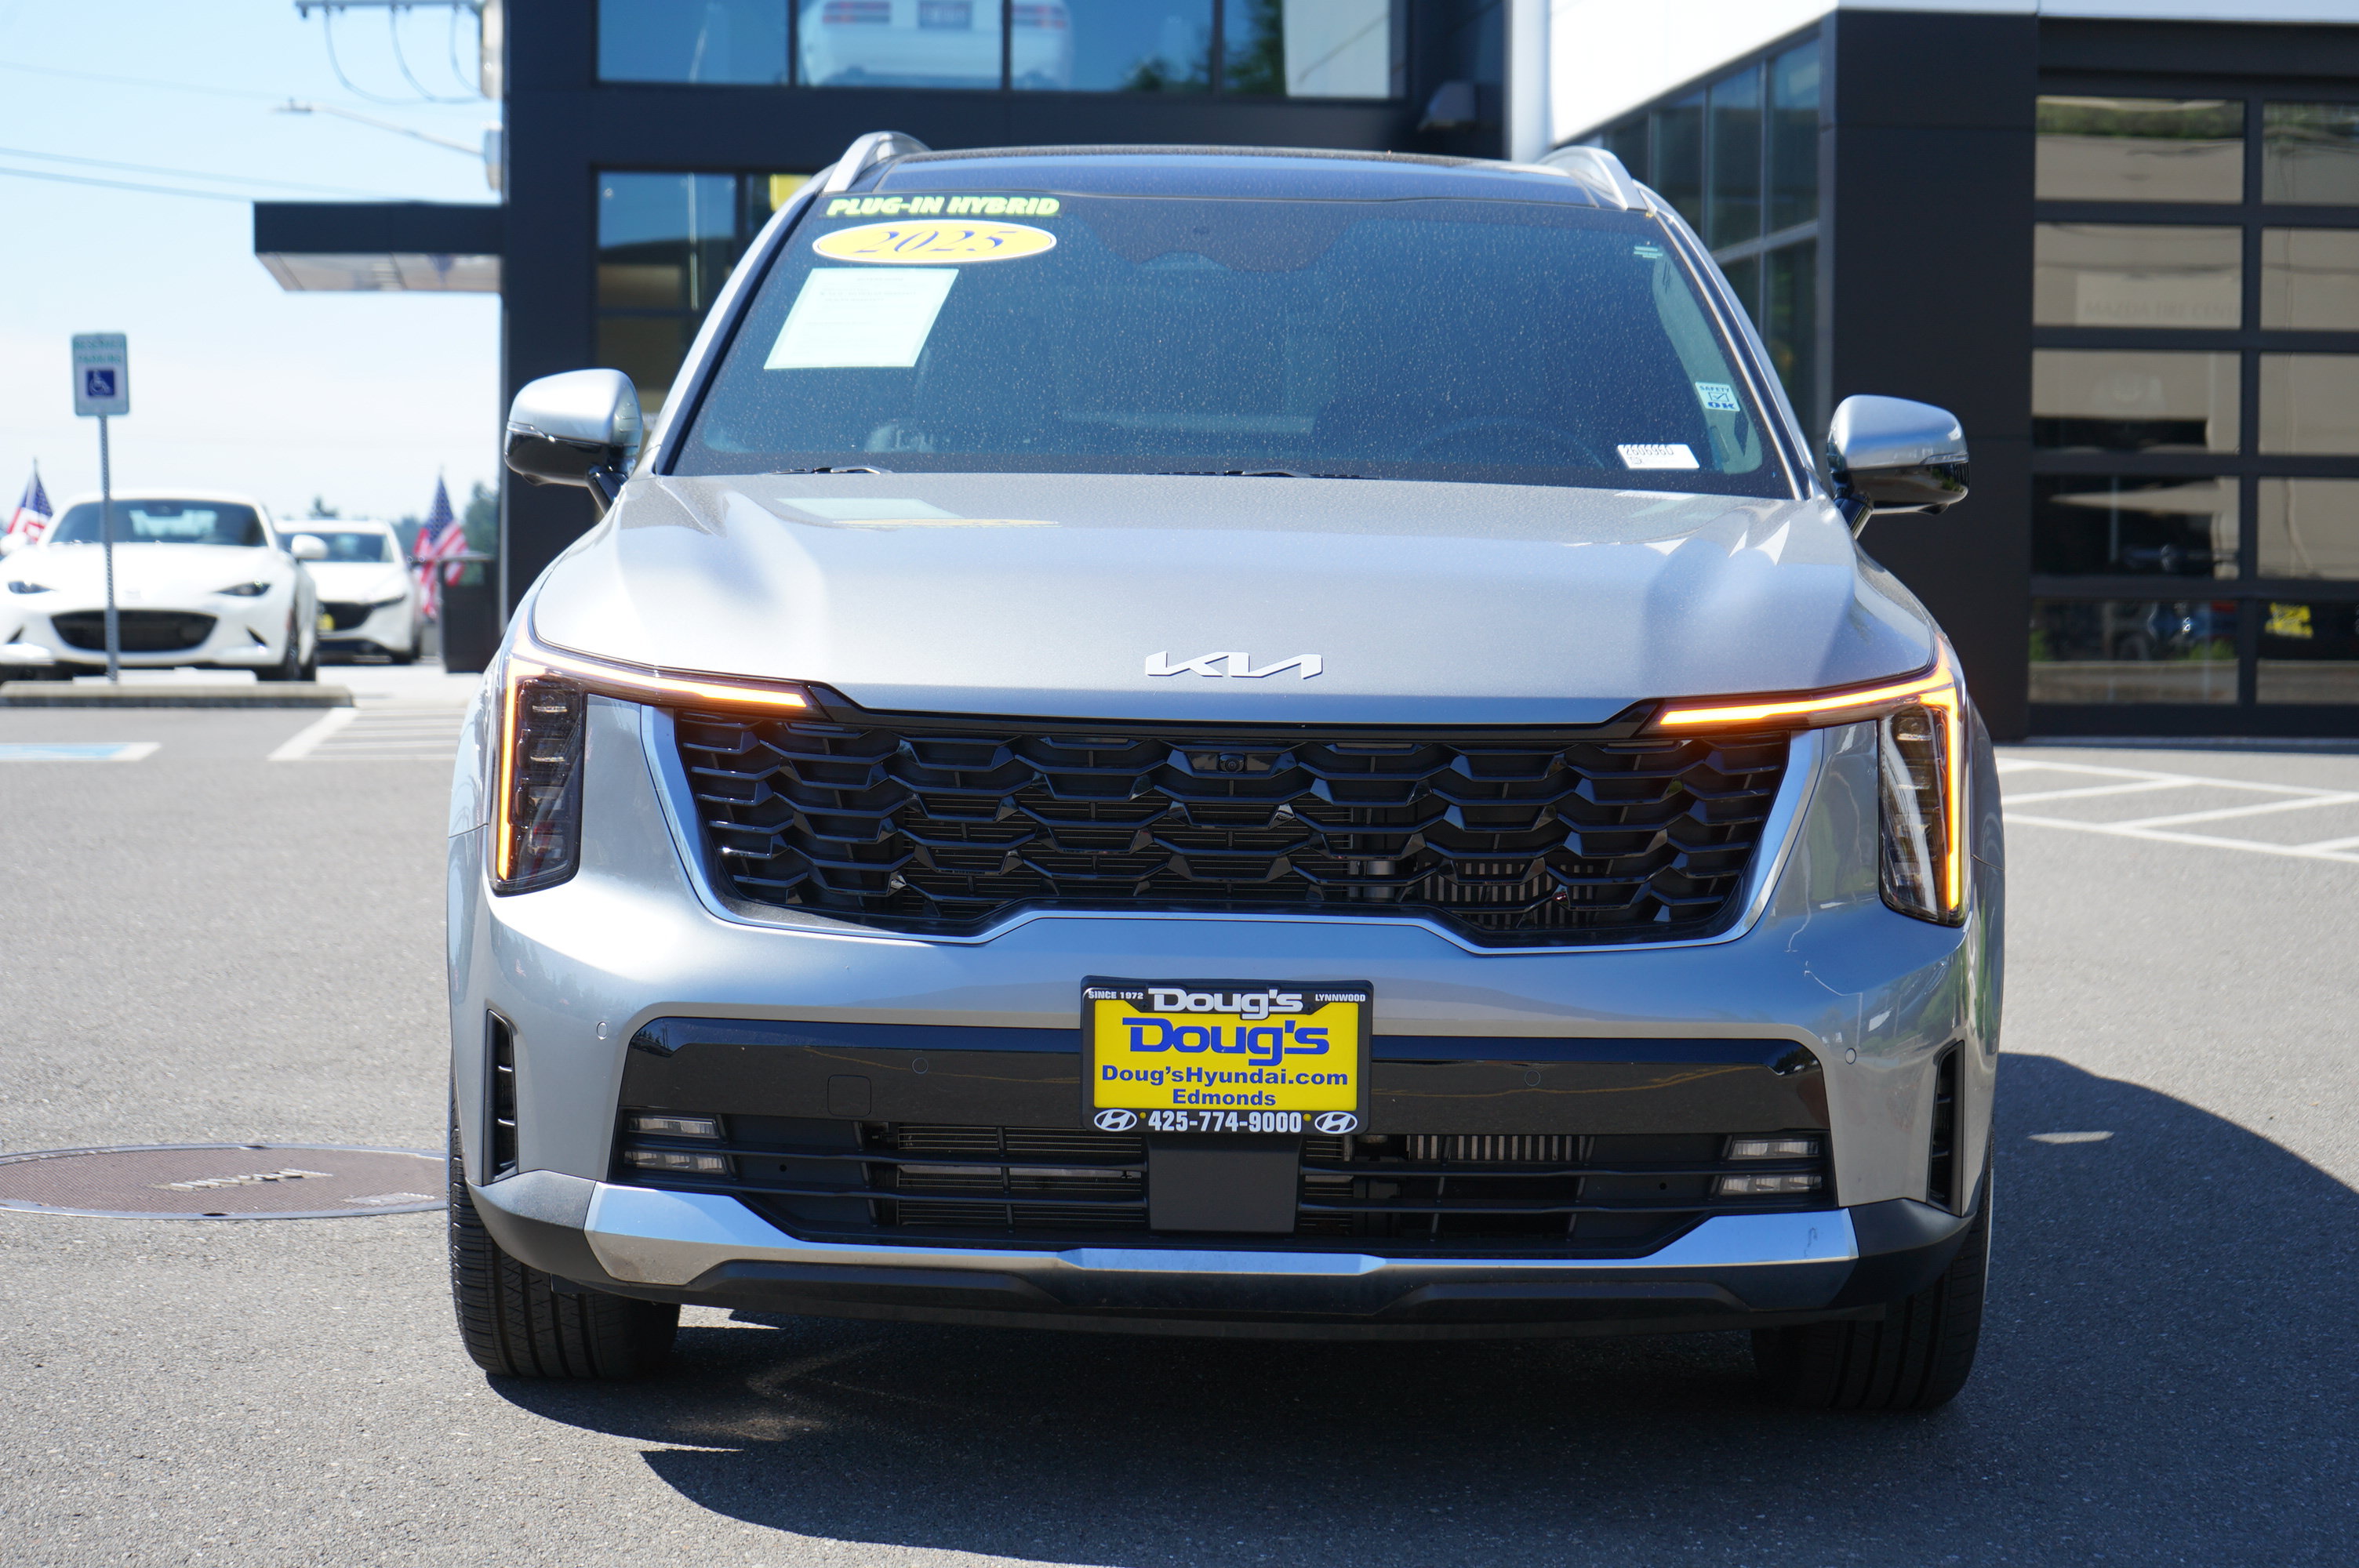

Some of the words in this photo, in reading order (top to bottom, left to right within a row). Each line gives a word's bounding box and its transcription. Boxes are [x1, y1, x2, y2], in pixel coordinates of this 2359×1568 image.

[826, 196, 945, 216] PLUG-IN
[946, 196, 1060, 216] HYBRID
[852, 230, 1018, 253] 2025
[1146, 650, 1323, 680] KIA
[1088, 990, 1118, 1000] SINCE
[1119, 991, 1144, 1000] 1972
[1147, 987, 1304, 1019] Doug's
[1314, 993, 1366, 1003] LYNNWOOD
[1121, 1017, 1330, 1066] Doug's
[1102, 1065, 1348, 1087] Doug'sHyundai.com
[1172, 1088, 1276, 1106] Edmonds
[1147, 1110, 1303, 1133] 425-774-9000
